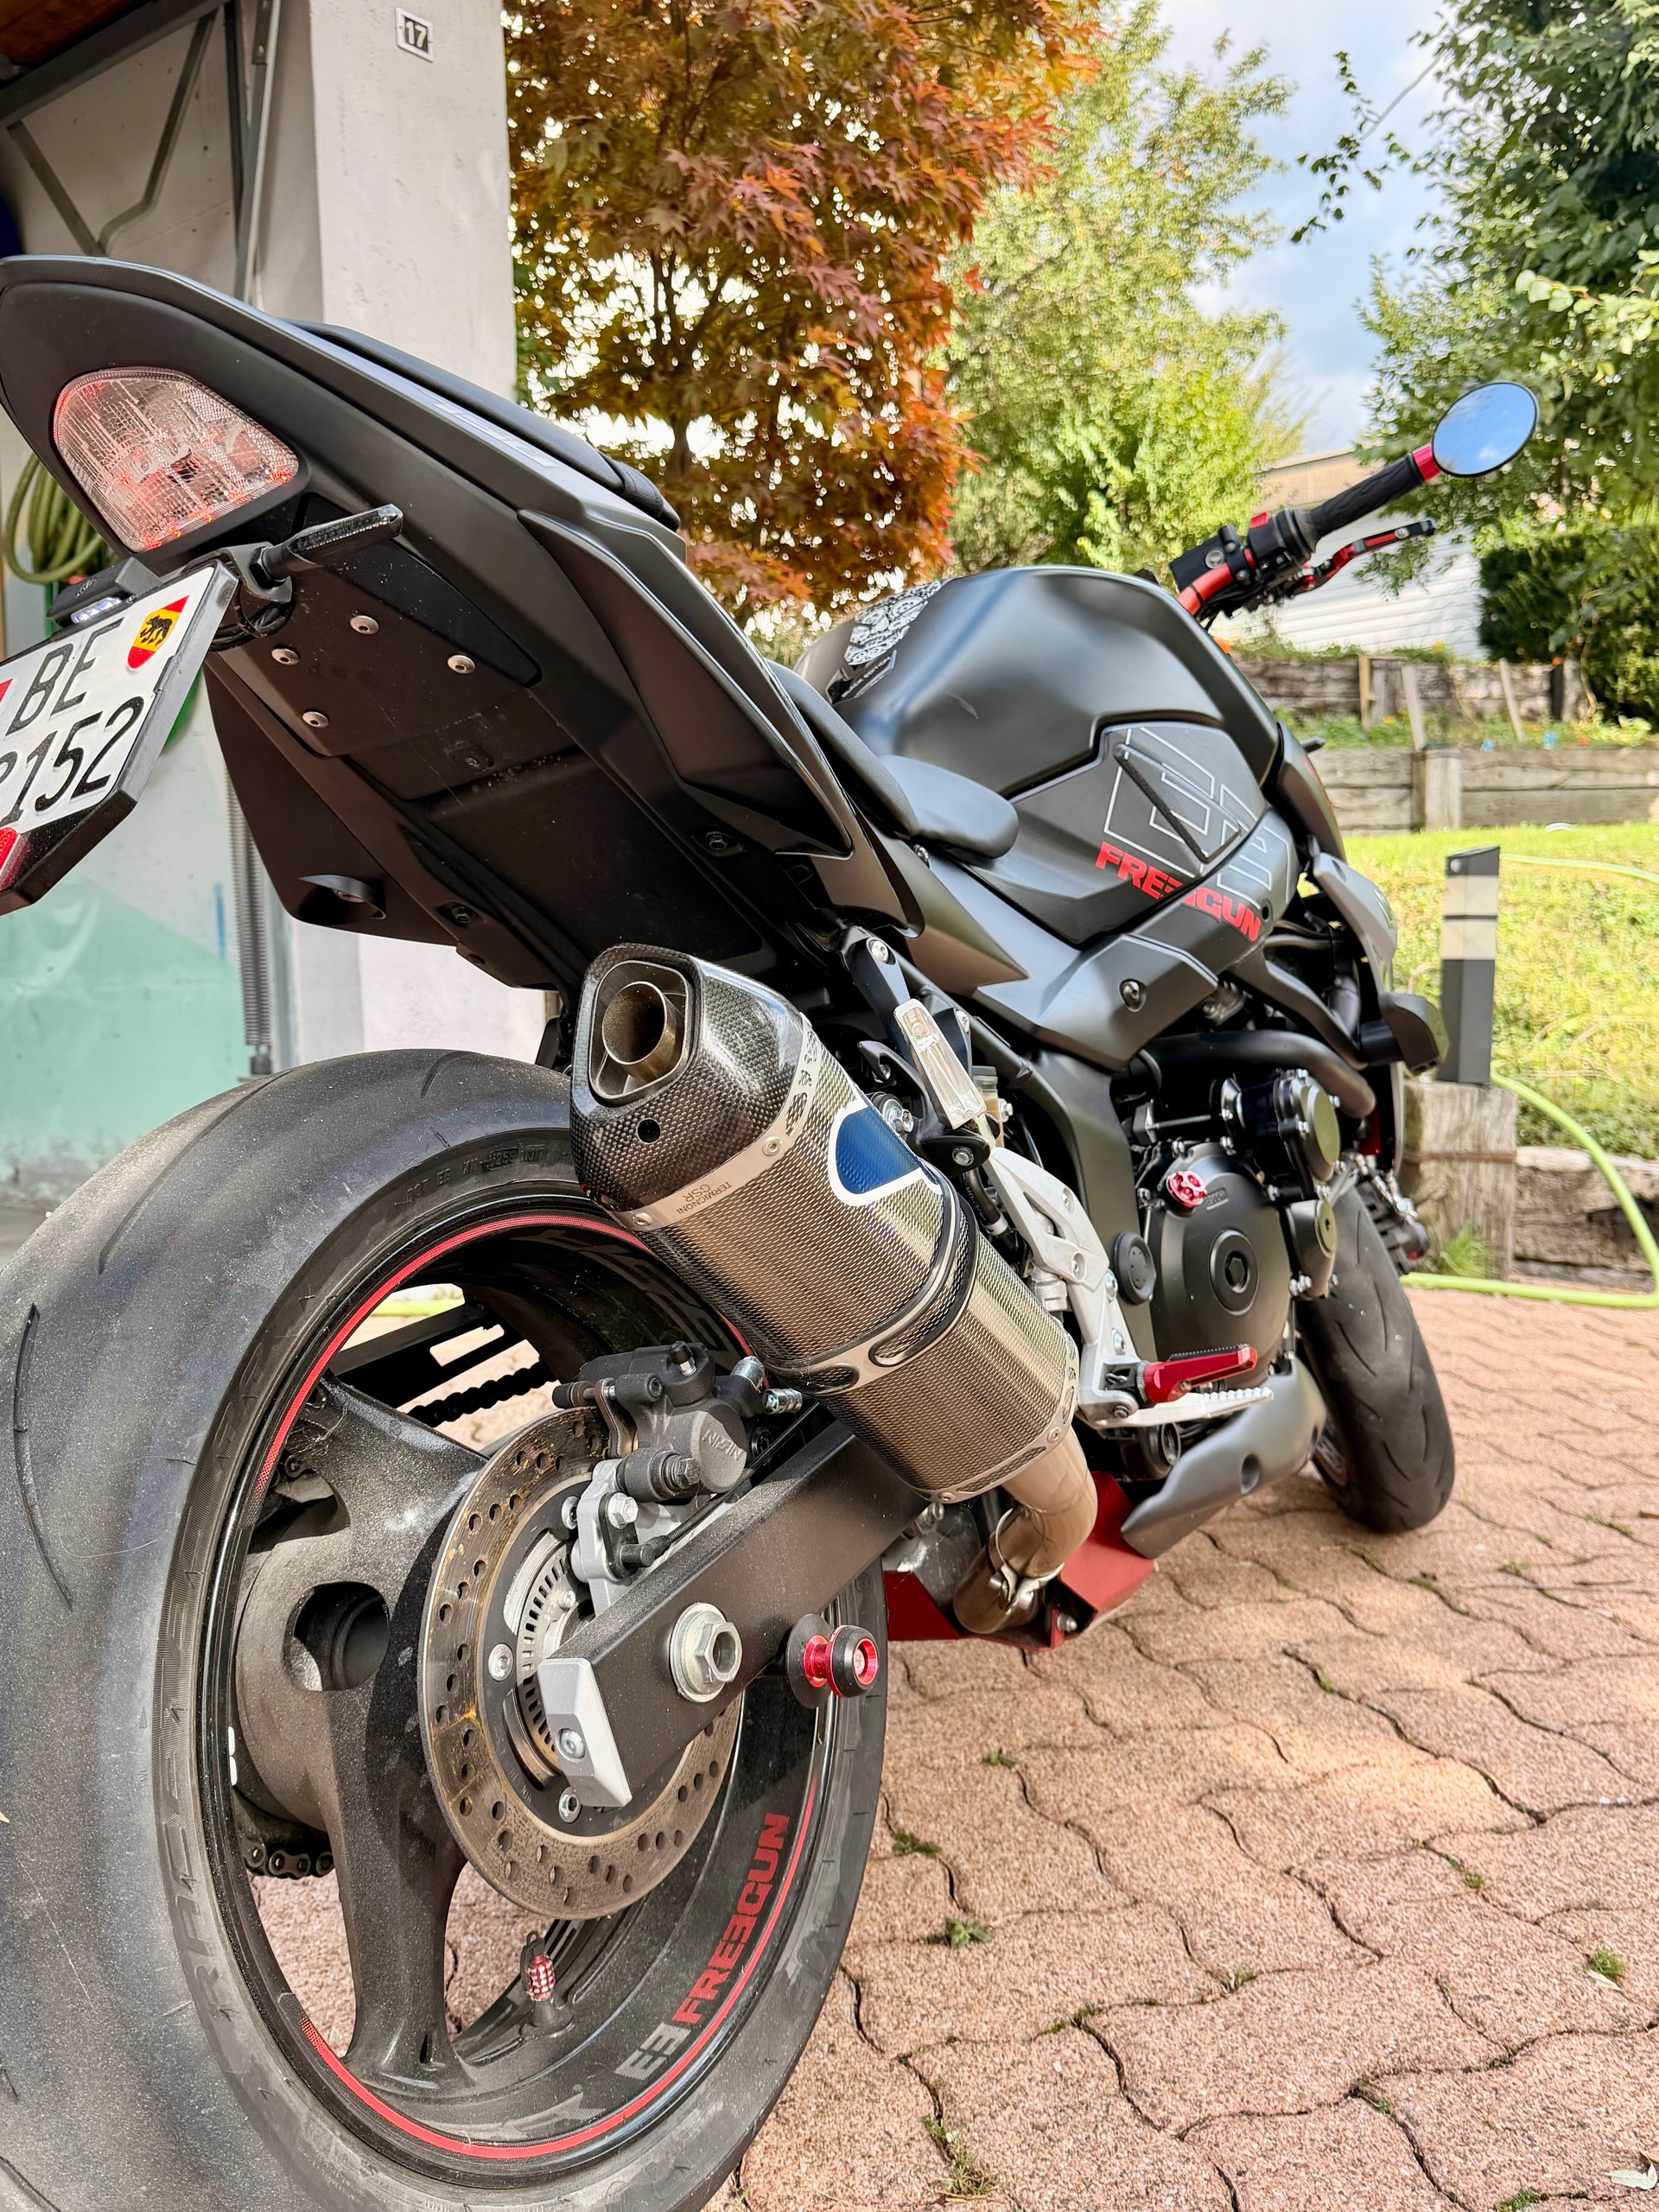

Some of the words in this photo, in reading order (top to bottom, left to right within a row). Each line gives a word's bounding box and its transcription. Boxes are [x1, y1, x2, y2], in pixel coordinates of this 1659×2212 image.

[405, 21, 427, 48] 17
[5, 616, 125, 736] BE
[676, 1181, 733, 1215] TERMIGNONI
[683, 1184, 711, 1203] GSR
[671, 1812, 790, 2024] FREEGUN
